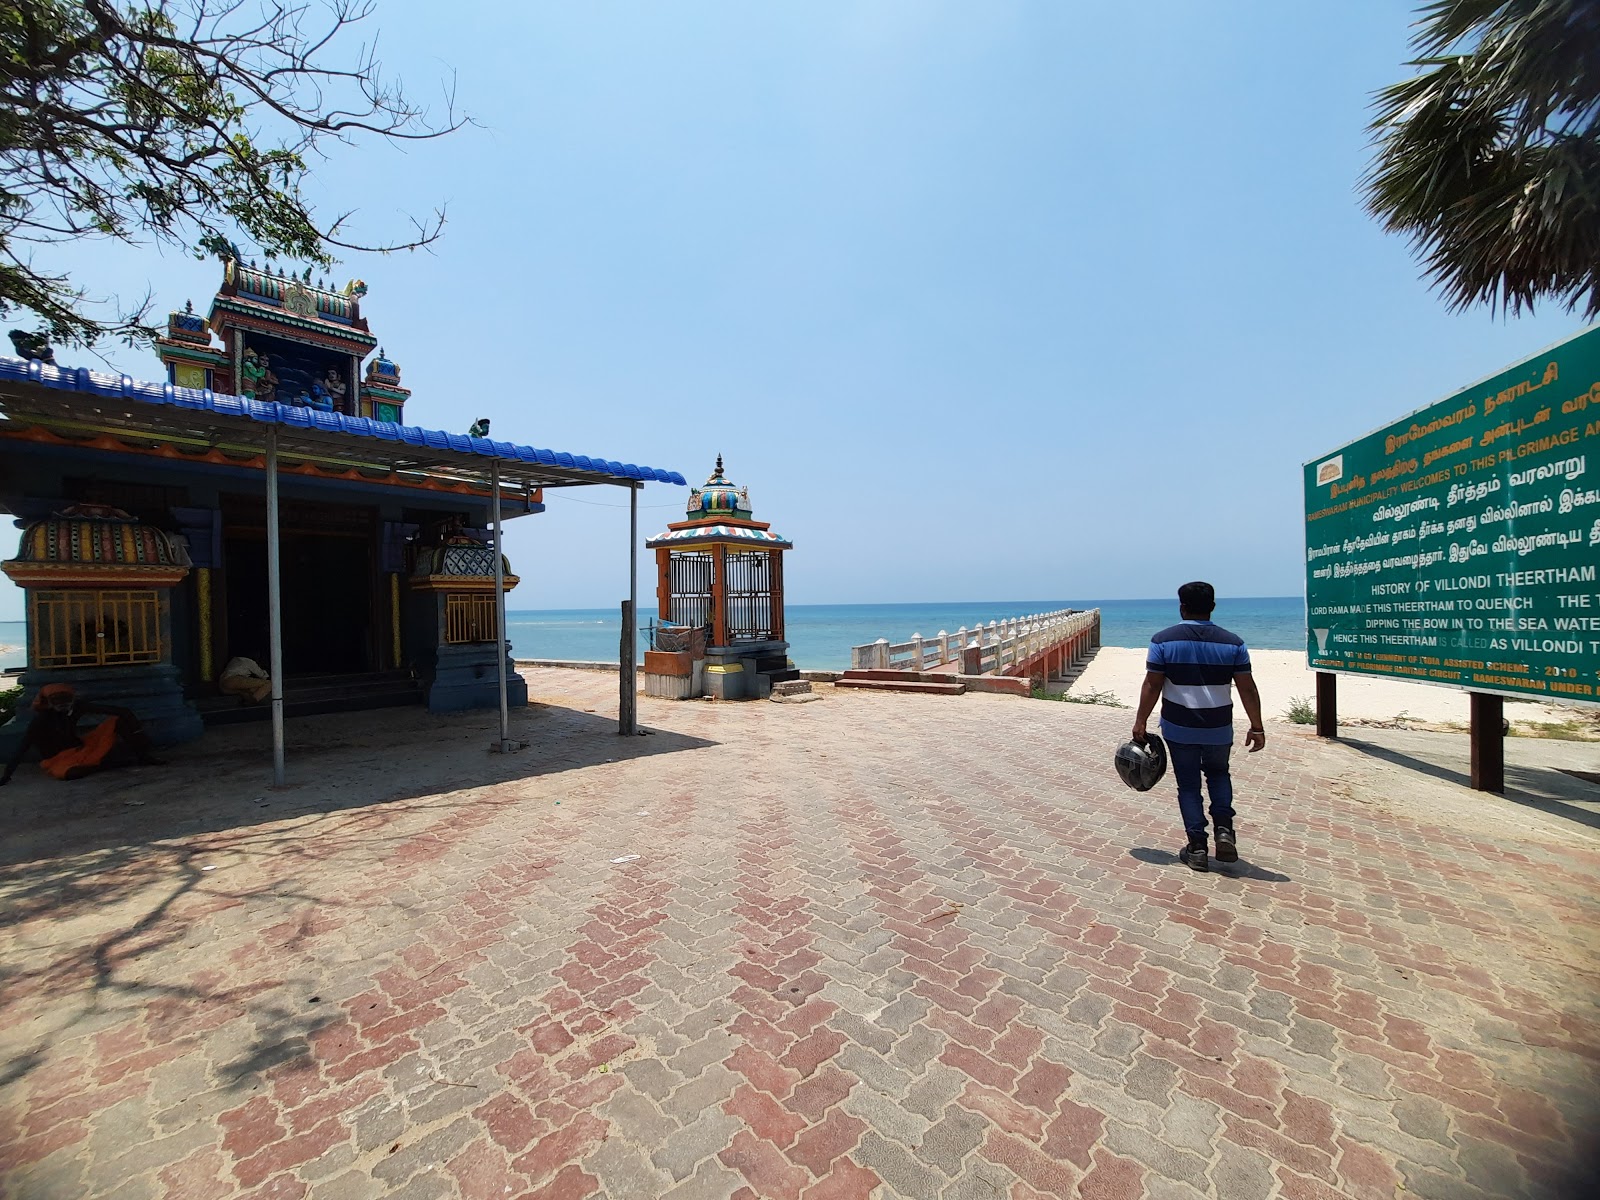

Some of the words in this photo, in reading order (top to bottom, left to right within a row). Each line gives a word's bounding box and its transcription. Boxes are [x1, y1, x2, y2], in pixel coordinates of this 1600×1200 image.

[1348, 486, 1398, 509] MUNICIPALITY
[1400, 469, 1450, 493] WELCOMES
[1454, 463, 1467, 476] TO
[1470, 454, 1495, 472] THIS
[1498, 427, 1579, 463] PILGRIMAGE
[1447, 473, 1501, 508] தீர்த்தம்
[1509, 455, 1585, 487] வரலாறு
[1447, 515, 1477, 536] தனது
[1480, 495, 1553, 524] வில்லினால்
[1371, 582, 1411, 596] HISTORY
[1415, 580, 1430, 592] OF
[1435, 575, 1490, 591] VILLONDI
[1496, 565, 1596, 587] THEERTHAM
[1311, 606, 1327, 615] LORD
[1328, 605, 1349, 614] RAMA
[1373, 603, 1391, 612] THIS
[1393, 600, 1454, 612] THEERTHAM
[1456, 600, 1472, 610] TO
[1475, 597, 1533, 610] QUENCH
[1557, 594, 1591, 608] THE
[1366, 619, 1399, 629] DIPPING
[1402, 619, 1421, 629] THE
[1423, 618, 1449, 629] BOW
[1452, 618, 1463, 628] IN
[1466, 618, 1483, 629] TO
[1487, 618, 1514, 629] THE
[1518, 618, 1548, 630] SEA
[1333, 634, 1358, 643] HENCE
[1360, 635, 1377, 644] THIS
[1380, 635, 1437, 646] THEERTHAM
[1450, 637, 1487, 648] CALLED
[1489, 638, 1508, 650] AS
[1511, 639, 1583, 654] VILLONDI
[1443, 659, 1484, 669] ASSISTED
[1486, 661, 1529, 673] SCHEME
[1429, 669, 1461, 680] CIRCUIT
[1550, 681, 1592, 695] UNDER
